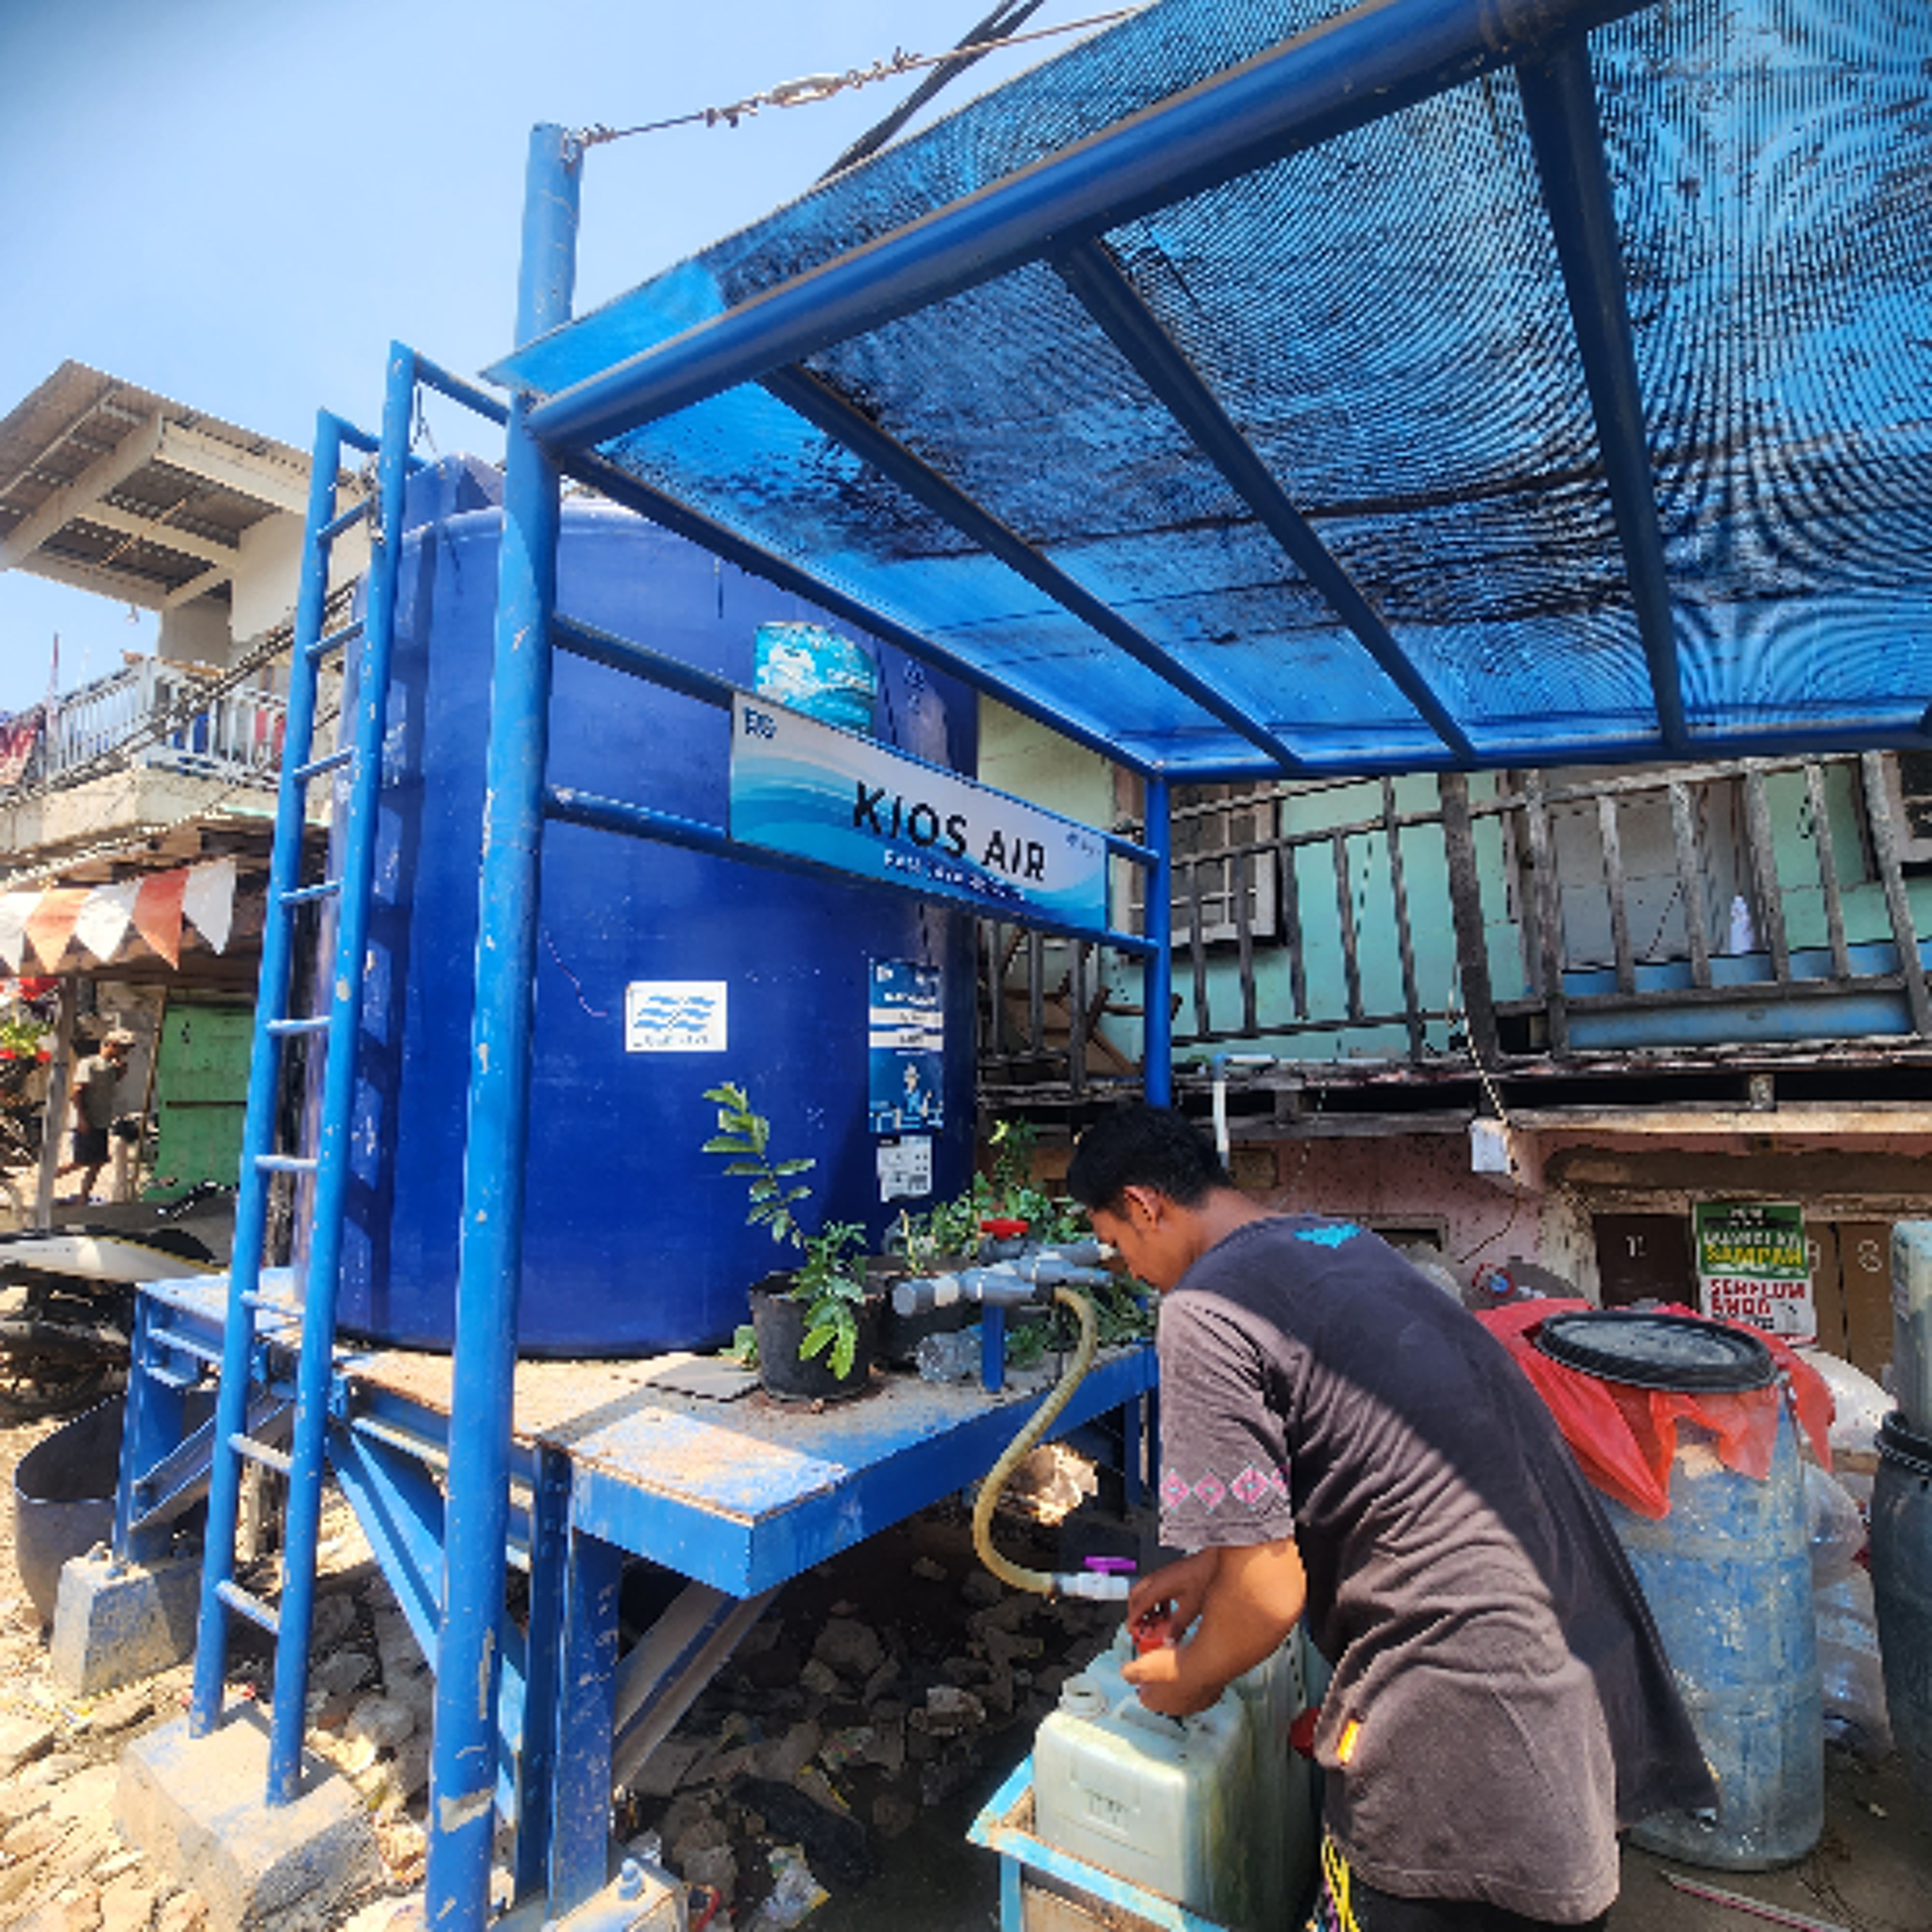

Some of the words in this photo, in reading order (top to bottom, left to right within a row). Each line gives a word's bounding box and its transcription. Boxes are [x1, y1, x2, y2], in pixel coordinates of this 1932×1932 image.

[853, 780, 967, 858] KIOS
[981, 829, 1044, 881] AIR
[1706, 1244, 1801, 1265] SAMPAH
